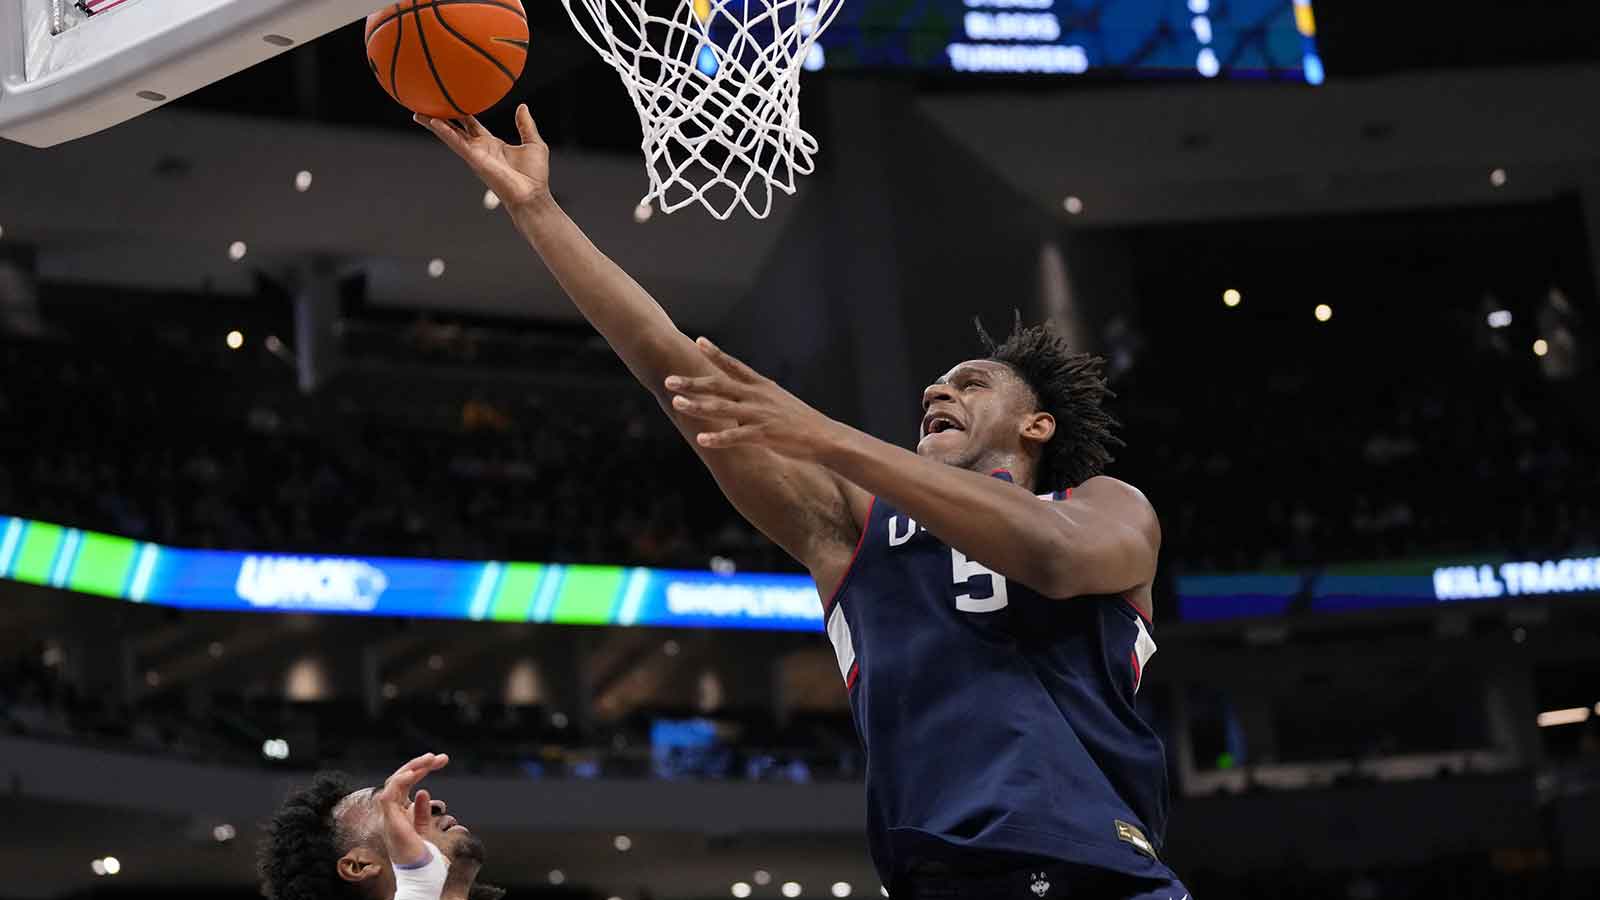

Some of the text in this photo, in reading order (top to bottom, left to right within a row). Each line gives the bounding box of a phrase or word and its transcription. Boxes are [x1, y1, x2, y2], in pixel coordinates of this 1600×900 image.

[965, 12, 1059, 40] BLOCKS
[948, 43, 1087, 73] TURNOVERS
[951, 547, 1008, 613] 5
[1434, 557, 1600, 600] KILL TRACK
